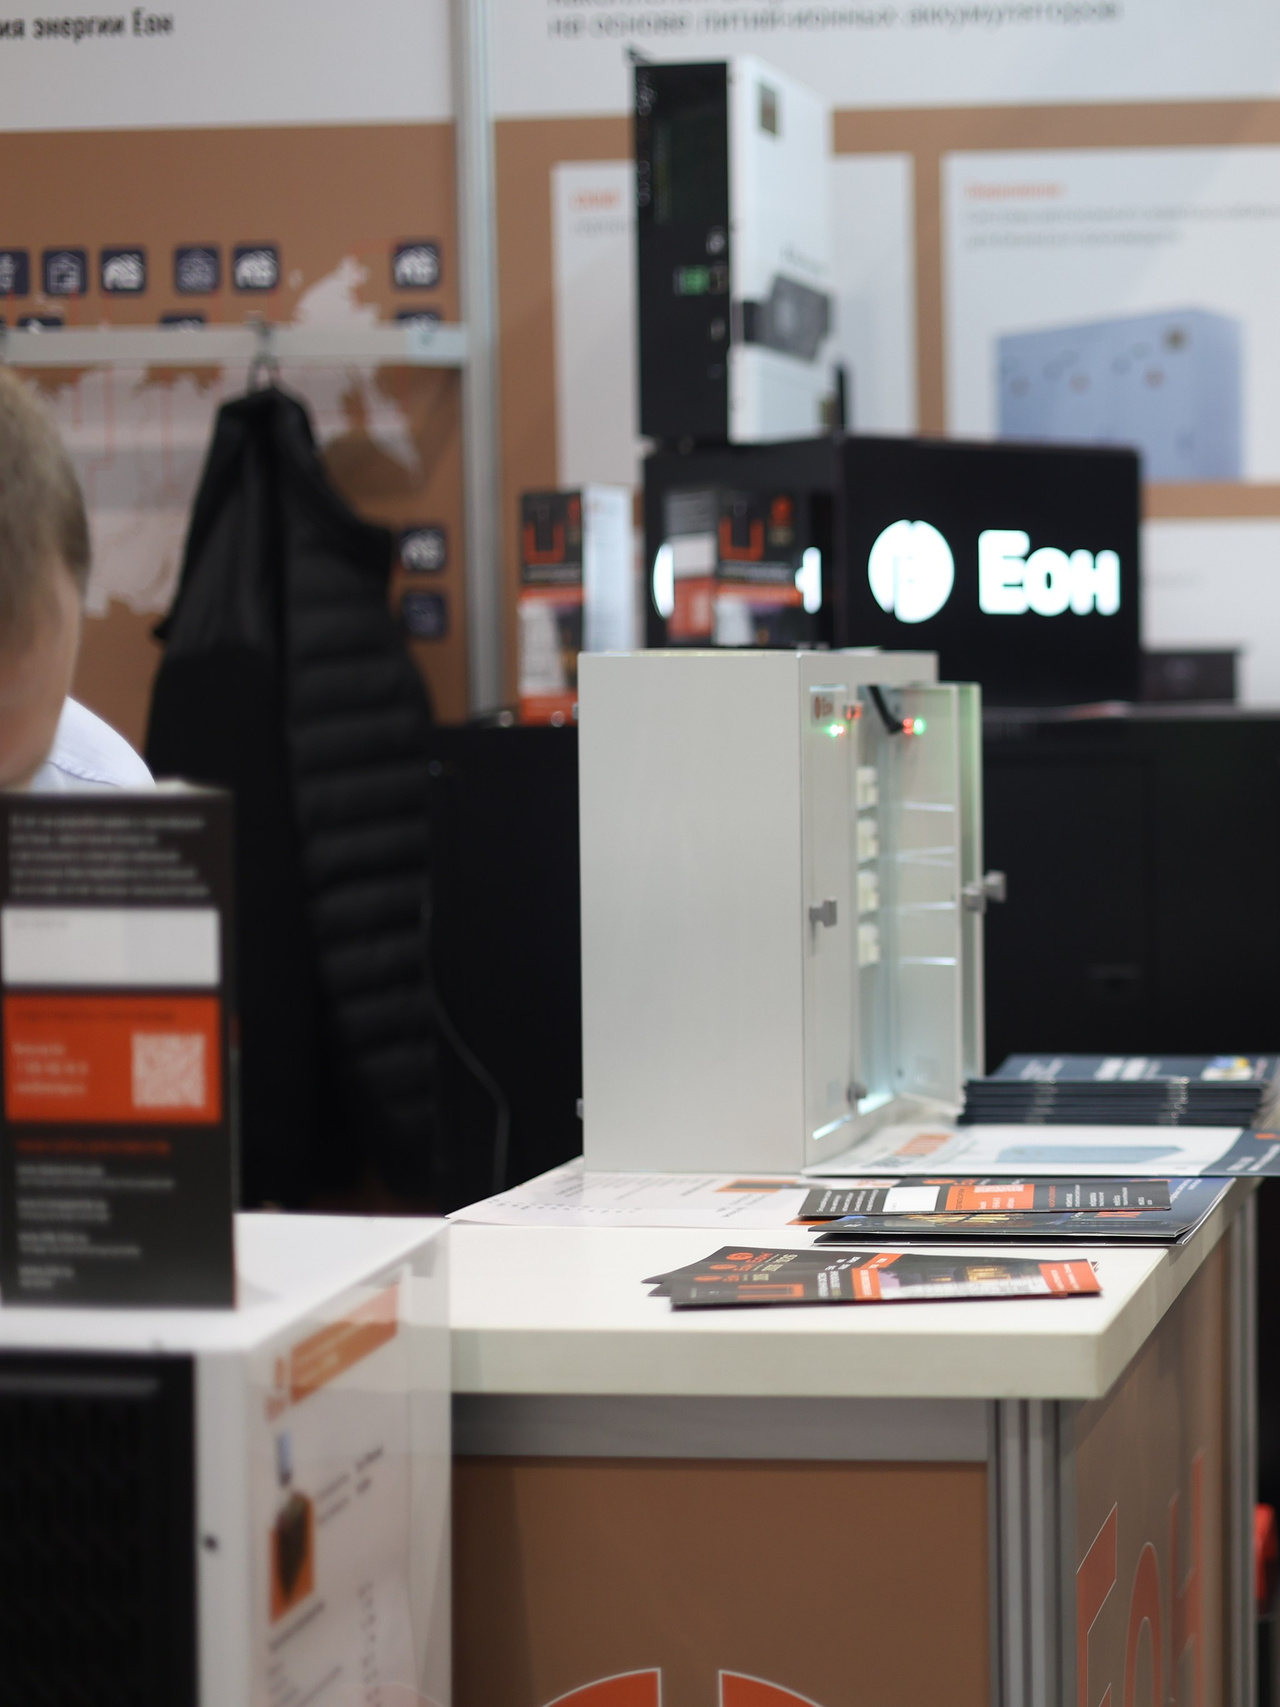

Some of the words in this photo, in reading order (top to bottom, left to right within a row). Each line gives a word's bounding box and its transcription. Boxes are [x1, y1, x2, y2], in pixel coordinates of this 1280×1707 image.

[34, 15, 126, 44] энергии
[132, 7, 174, 37] Еон
[978, 529, 1121, 617] Еон
